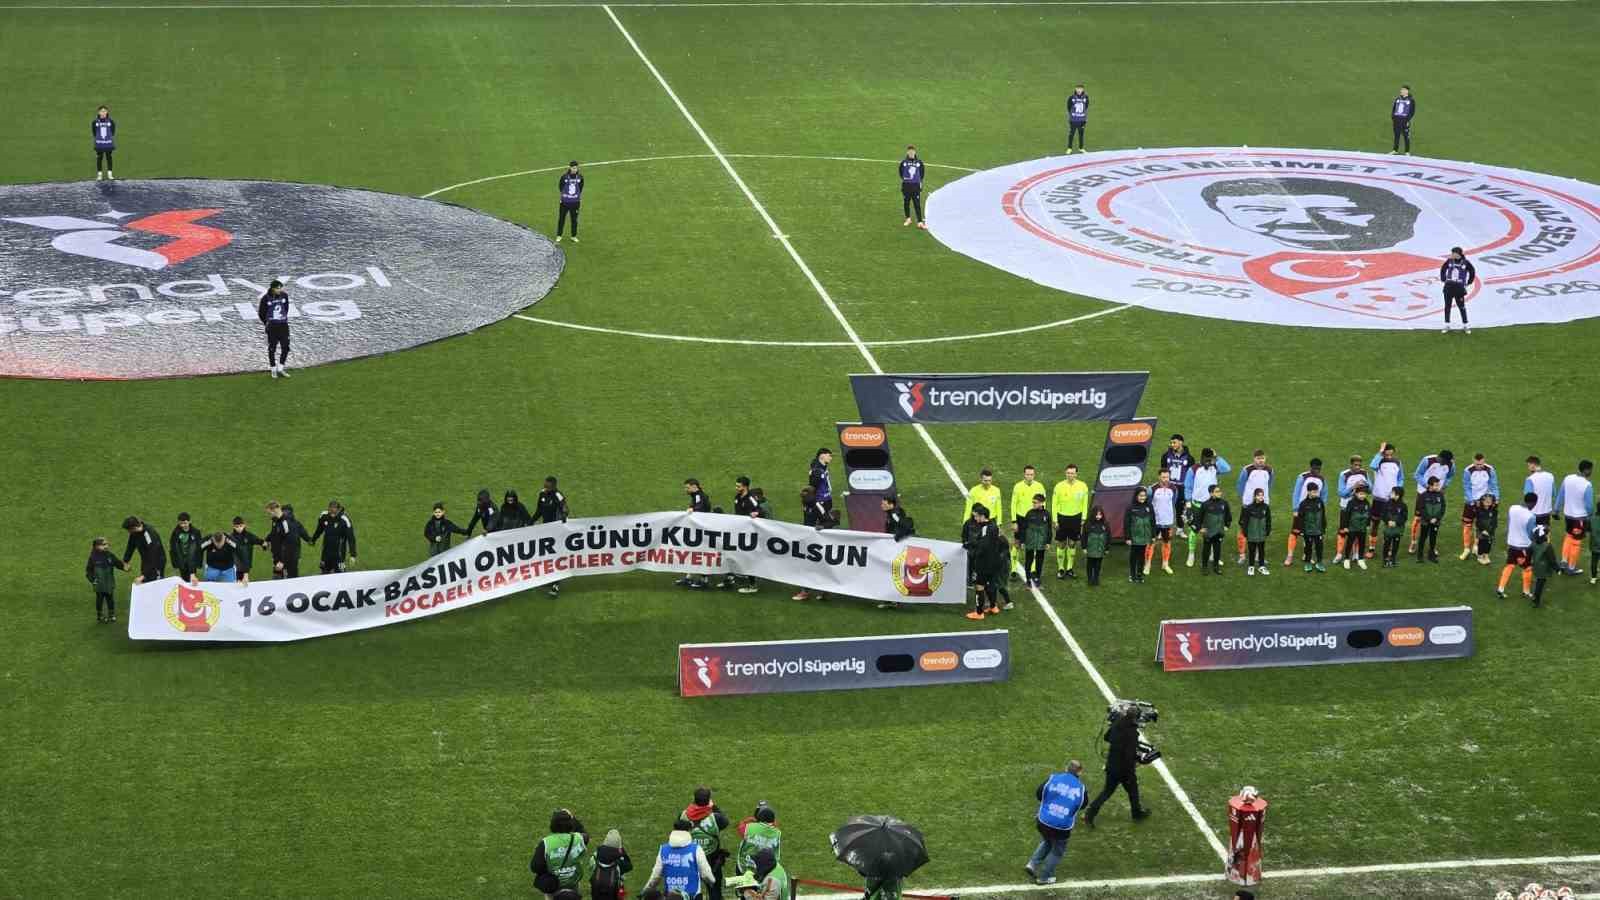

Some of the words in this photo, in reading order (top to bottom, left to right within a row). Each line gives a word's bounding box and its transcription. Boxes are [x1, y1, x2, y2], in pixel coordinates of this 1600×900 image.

[1180, 159, 1391, 174] MEHMET
[1041, 172, 1119, 206] SÜPER
[1472, 182, 1575, 224] YILMAZ
[1048, 208, 1215, 266] TRENDYOL
[1479, 222, 1579, 267] SEZONU
[1132, 277, 1253, 300] 2025
[1495, 279, 1600, 301] 2026
[928, 385, 1028, 410] trendyol
[1028, 386, 1108, 410] SüperLig
[844, 430, 882, 442] trendyol
[238, 595, 277, 618] 16
[284, 587, 377, 614] OCAK
[384, 558, 468, 601] BASIN
[474, 535, 556, 571] ONUR
[565, 523, 653, 551] GÜNÜ
[661, 526, 758, 552] KUTLU
[766, 537, 868, 567] OLSUN
[1205, 632, 1279, 656] trendyol
[725, 658, 803, 680] trendyol
